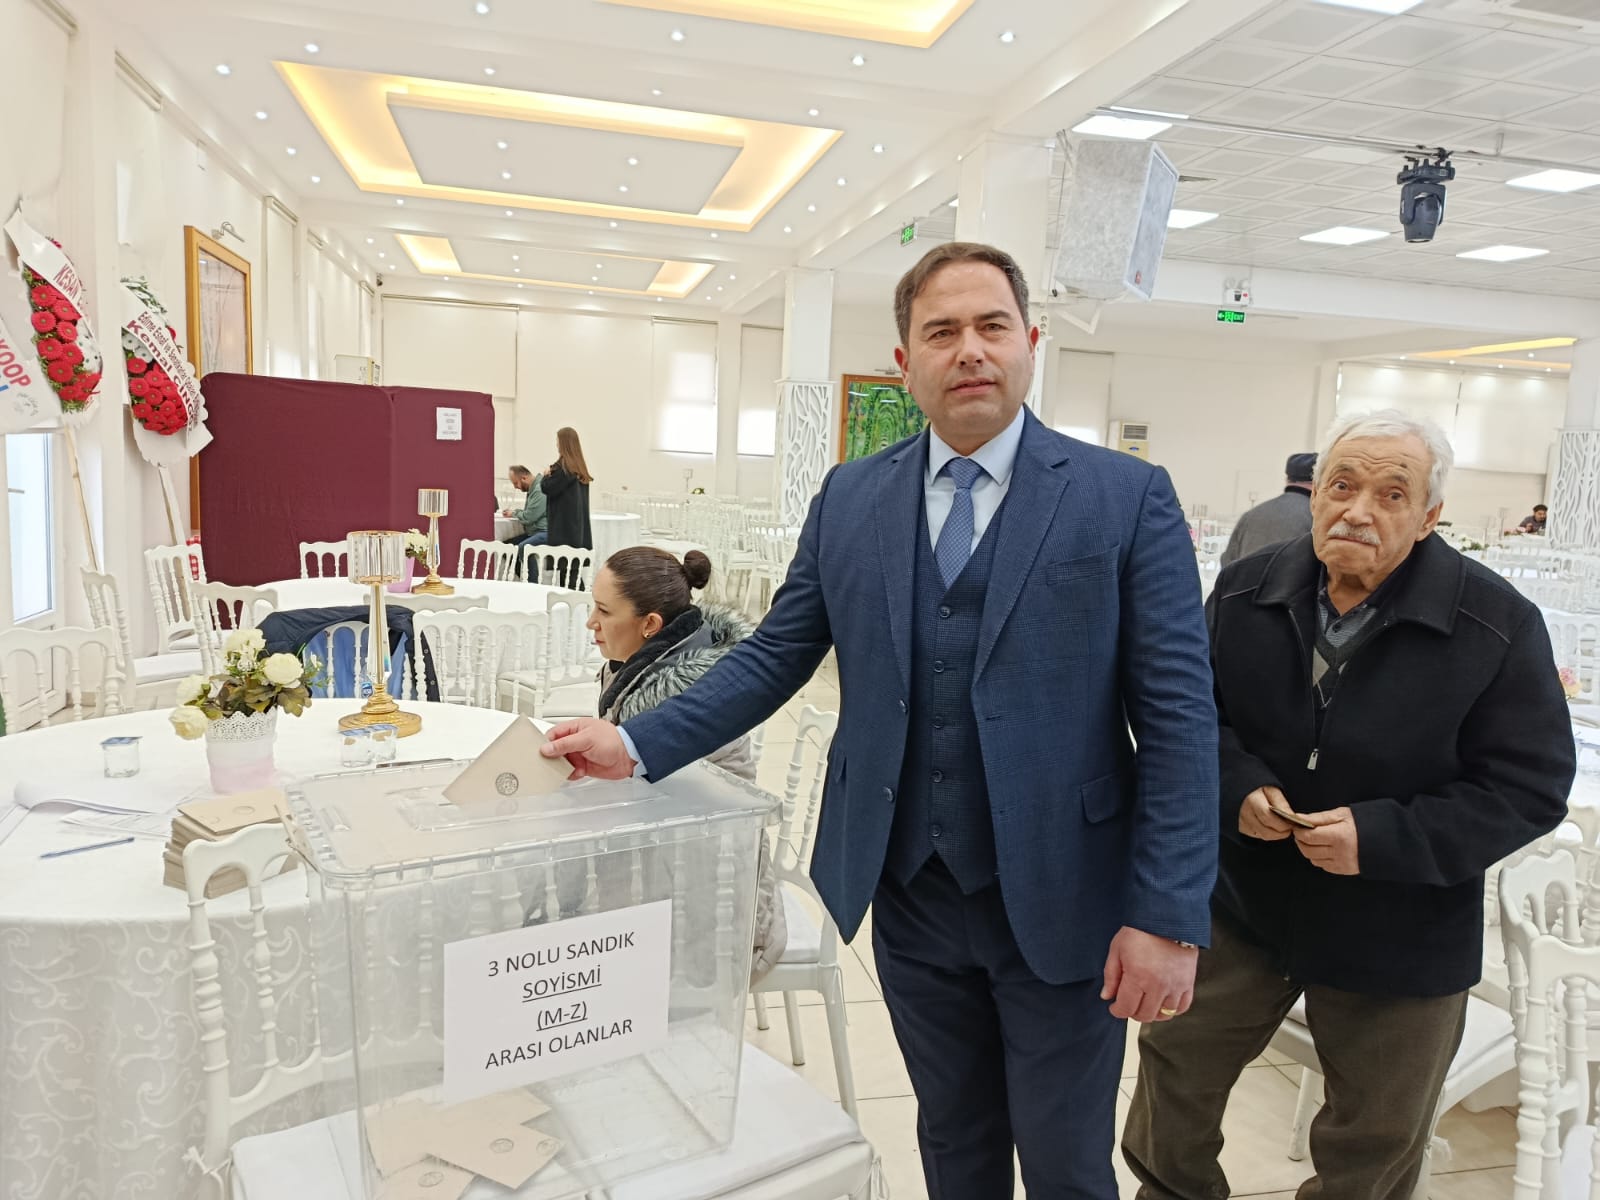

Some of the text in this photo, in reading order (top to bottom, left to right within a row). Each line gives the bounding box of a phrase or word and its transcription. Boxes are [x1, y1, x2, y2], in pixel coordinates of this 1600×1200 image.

[127, 320, 172, 371] Kemal
[488, 932, 634, 976] 3 NOLU SANDIK
[522, 965, 602, 999] SOYİSMİ
[537, 1001, 588, 1031] (M-Z)
[485, 1019, 633, 1069] ARASI OLANLAR
